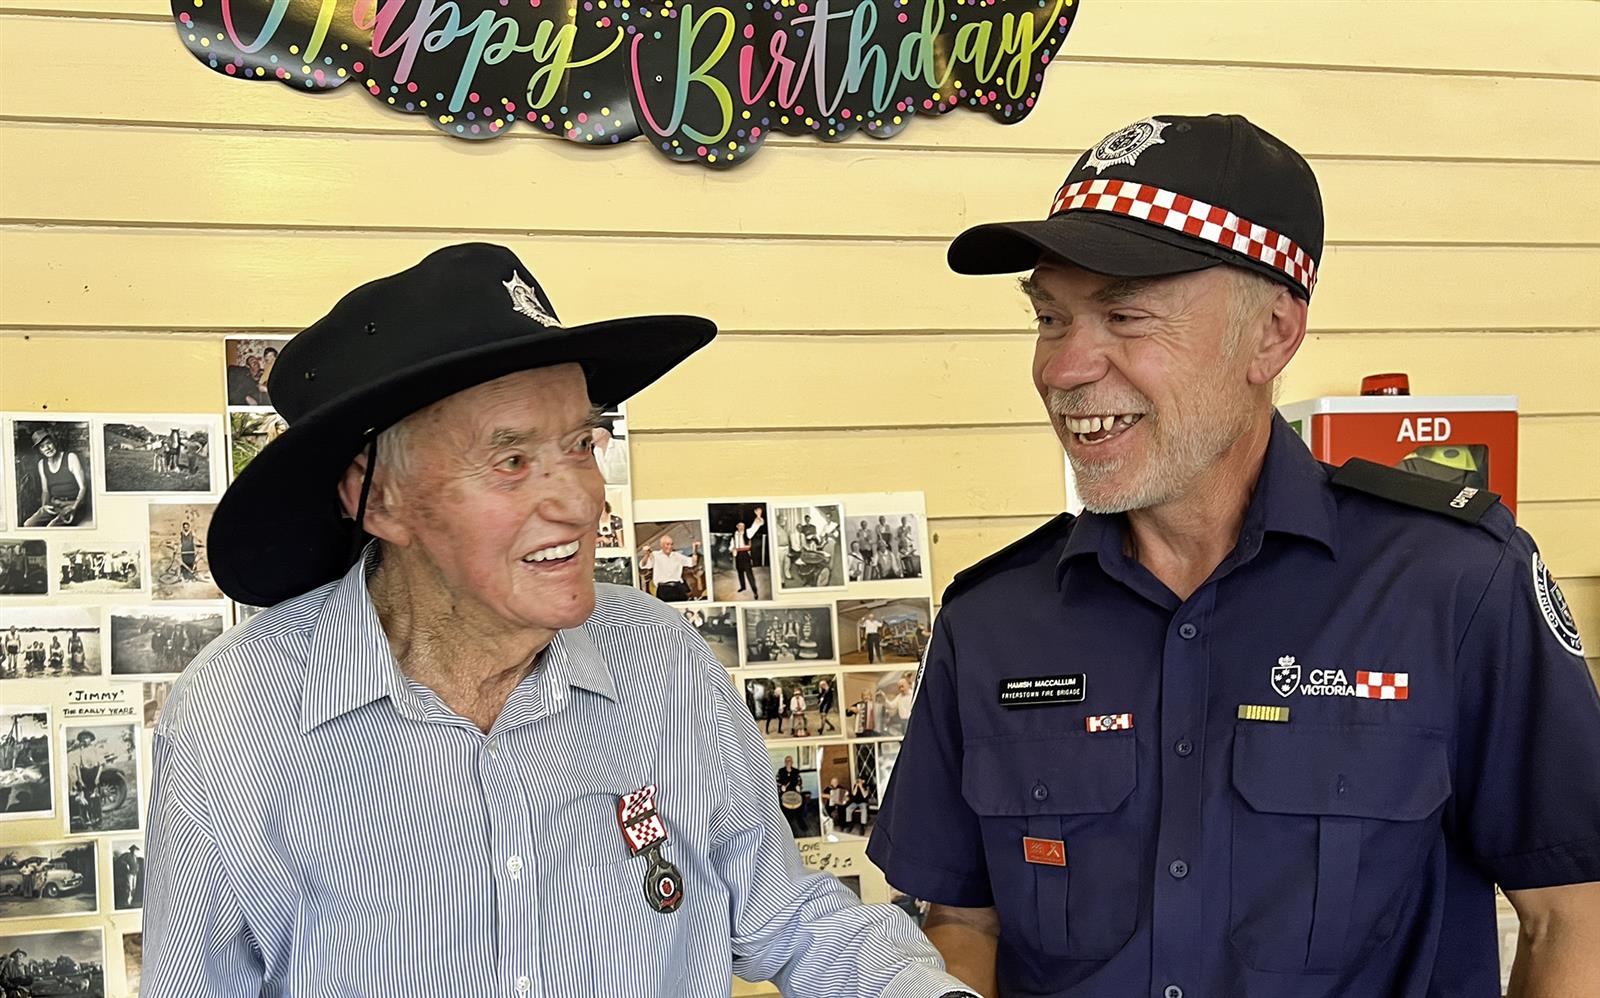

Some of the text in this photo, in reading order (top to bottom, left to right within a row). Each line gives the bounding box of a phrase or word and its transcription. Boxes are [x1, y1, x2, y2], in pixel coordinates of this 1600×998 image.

[630, 0, 1063, 145] Birthday
[1396, 417, 1452, 442] AED
[1007, 678, 1077, 690] HAMISH MACCALLUM
[1309, 669, 1348, 686] CFA
[1056, 688, 1081, 697] BRIGADE
[1300, 684, 1356, 697] VICTORIA
